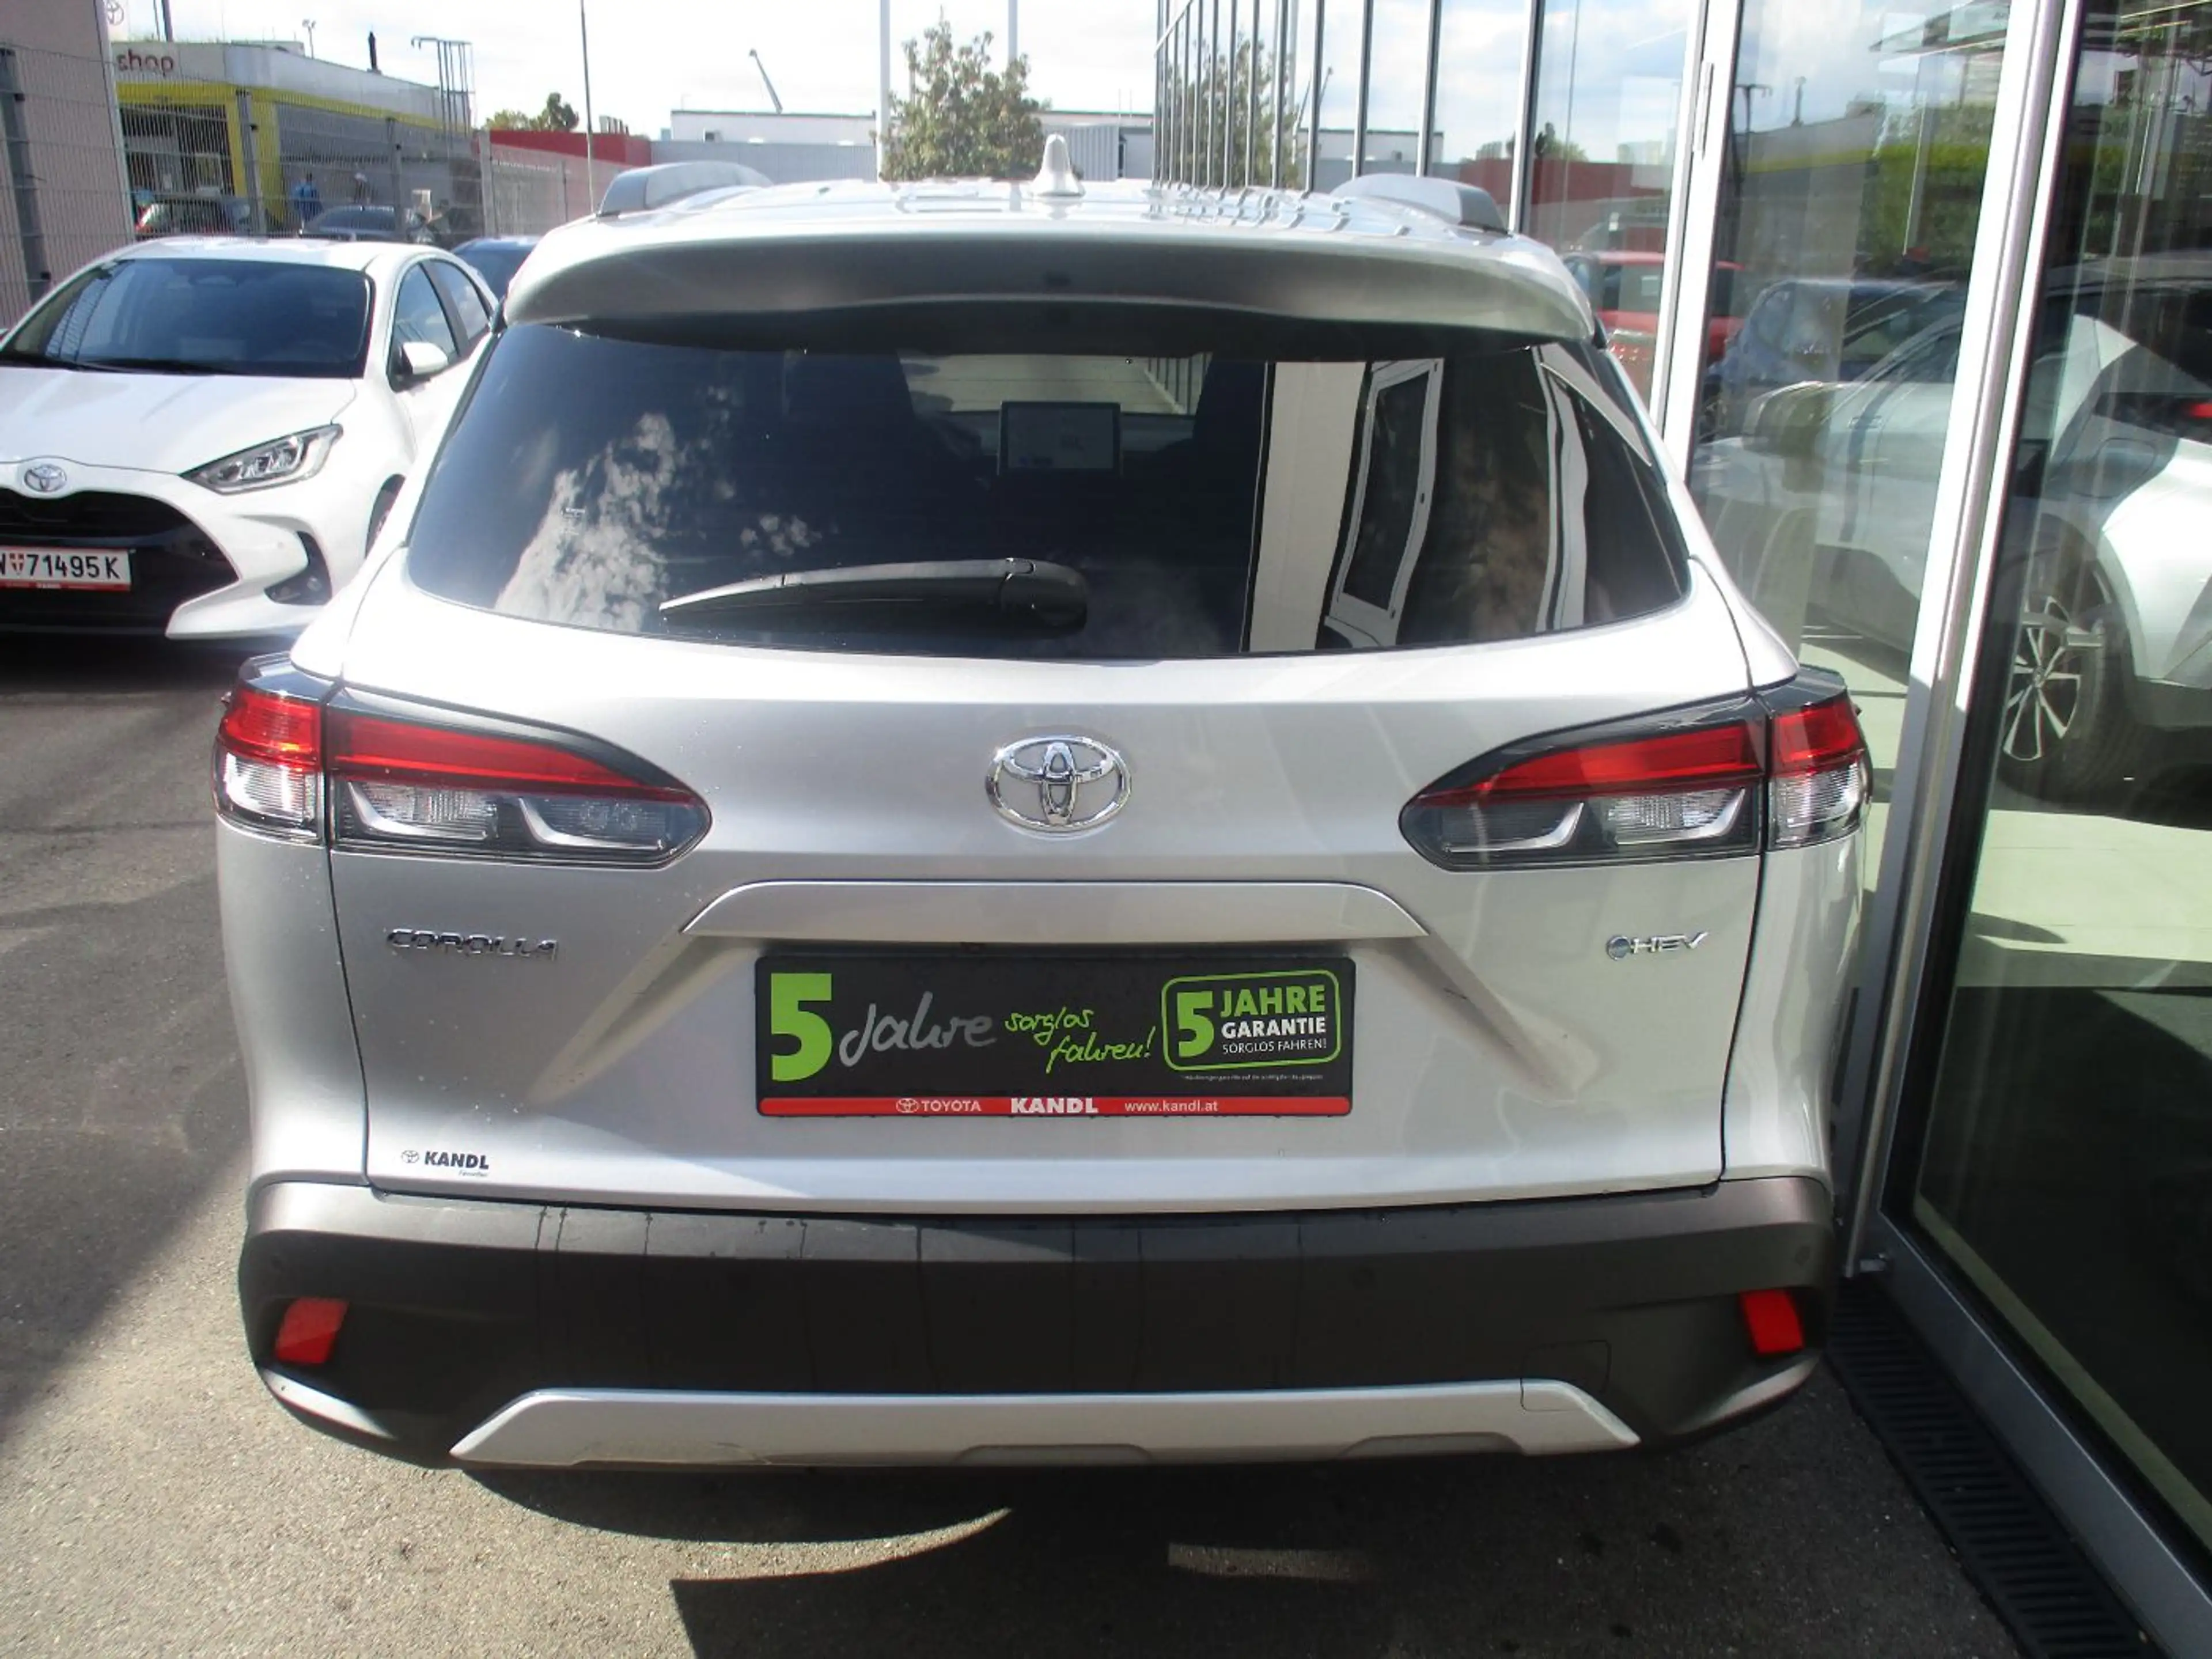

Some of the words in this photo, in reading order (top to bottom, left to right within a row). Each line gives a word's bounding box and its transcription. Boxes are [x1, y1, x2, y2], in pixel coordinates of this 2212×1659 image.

[116, 48, 174, 78] shop
[387, 928, 558, 961] COROLLA
[771, 973, 832, 1081] 5
[839, 990, 998, 1067] Jahre
[1005, 1006, 1094, 1046] sorglos
[1177, 990, 1214, 1058] 5
[1220, 984, 1325, 1018] JAHRE
[1221, 1017, 1327, 1039] GARANTIE
[1046, 1025, 1156, 1074] fahren!
[1222, 1041, 1275, 1055] SORGLOS
[1278, 1038, 1327, 1052] FAHREN!
[922, 1100, 982, 1112] TOYOTA
[1011, 1097, 1099, 1113] KANDL
[1124, 1097, 1219, 1112] www.kandl.at
[425, 1151, 489, 1170] KANDL
